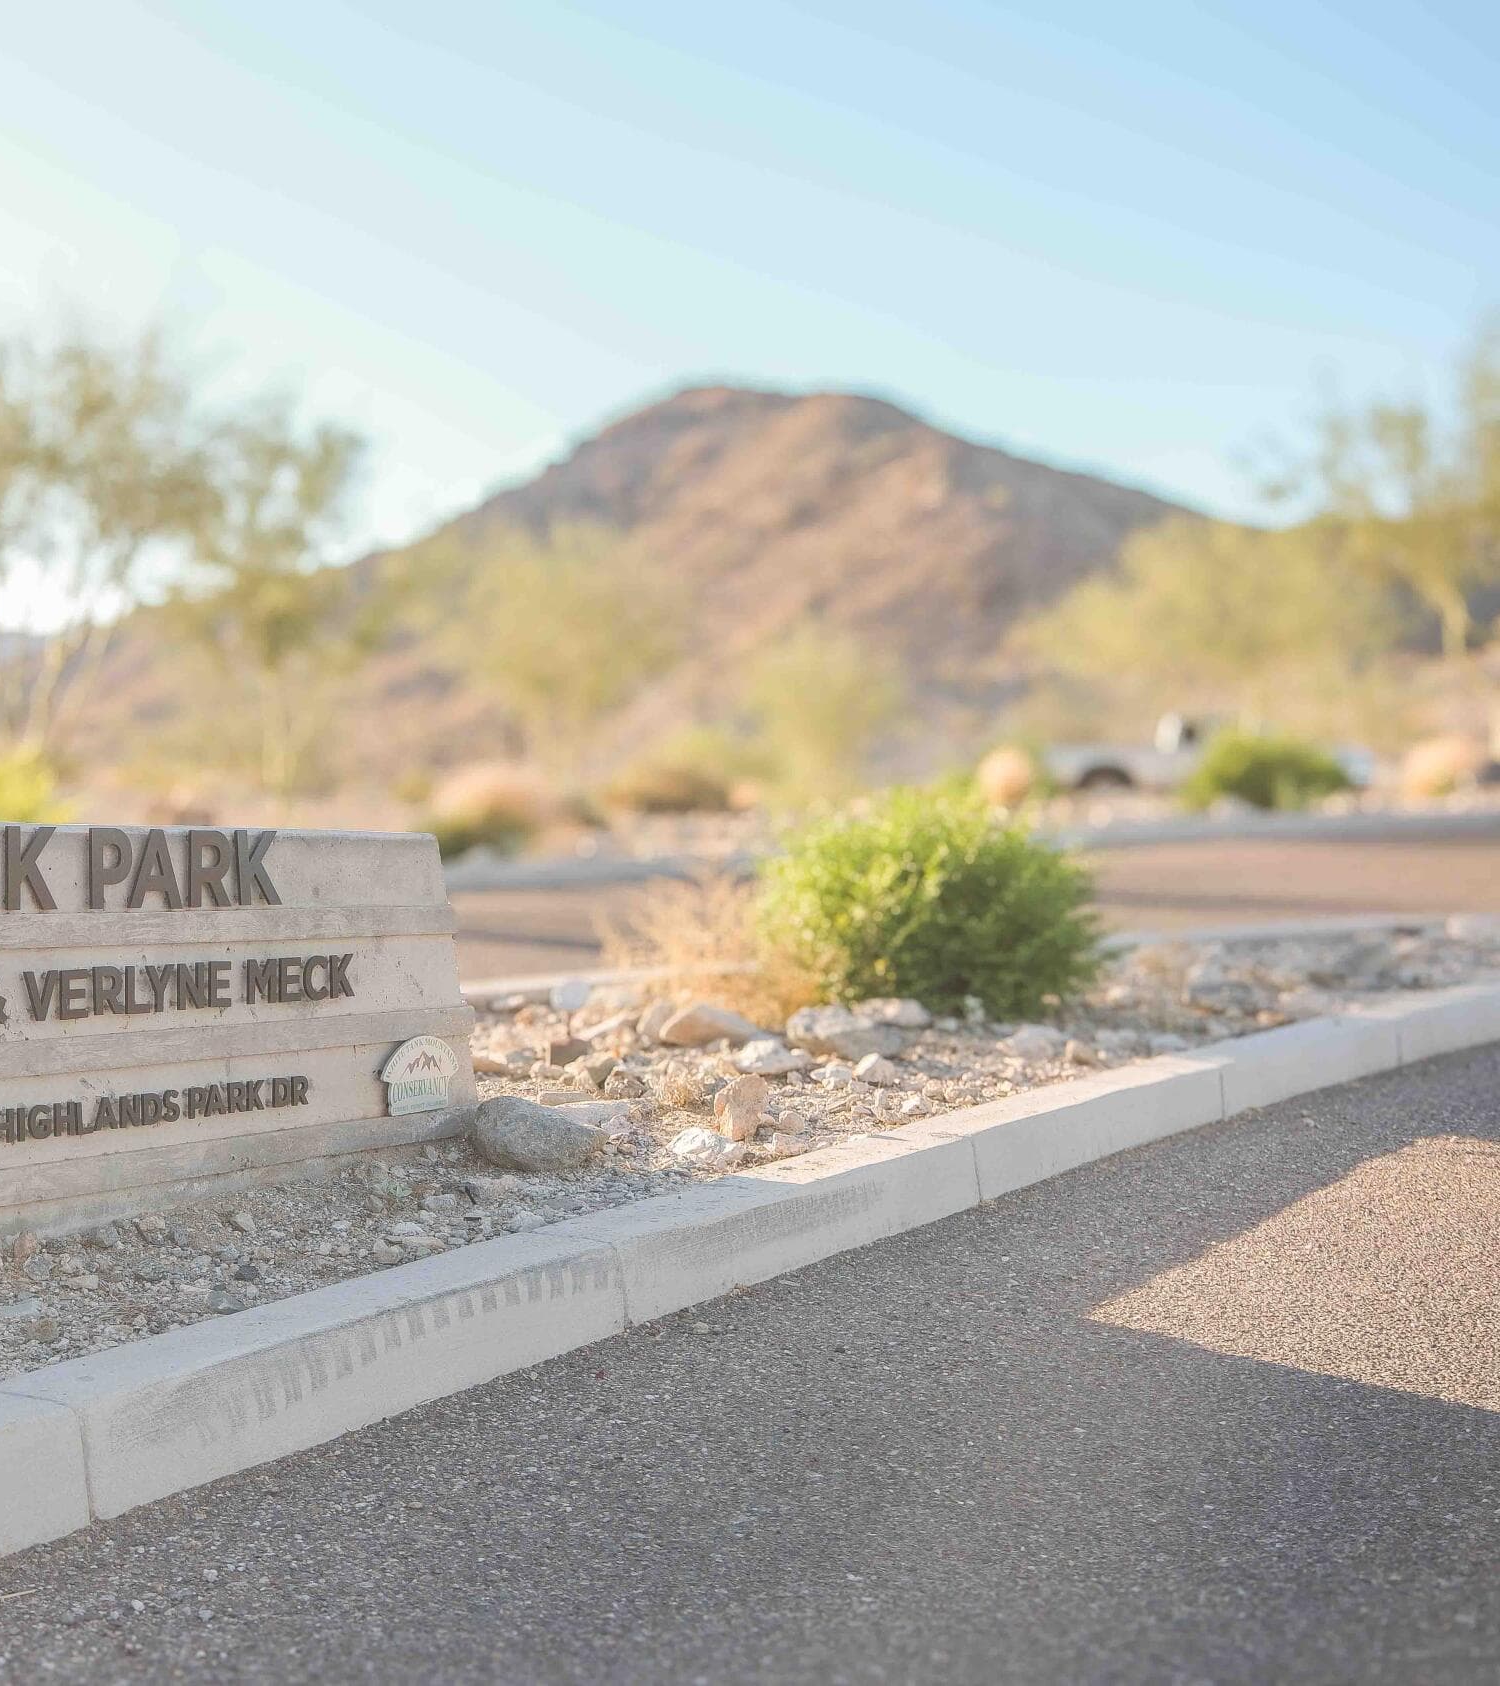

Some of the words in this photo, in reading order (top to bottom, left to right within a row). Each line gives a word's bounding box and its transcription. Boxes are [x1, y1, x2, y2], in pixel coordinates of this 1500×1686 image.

[88, 827, 284, 910] PARK
[22, 960, 232, 1022] VERLYNE
[245, 953, 355, 1005] MECK
[186, 1079, 265, 1119] PARK
[271, 1075, 309, 1108] DR
